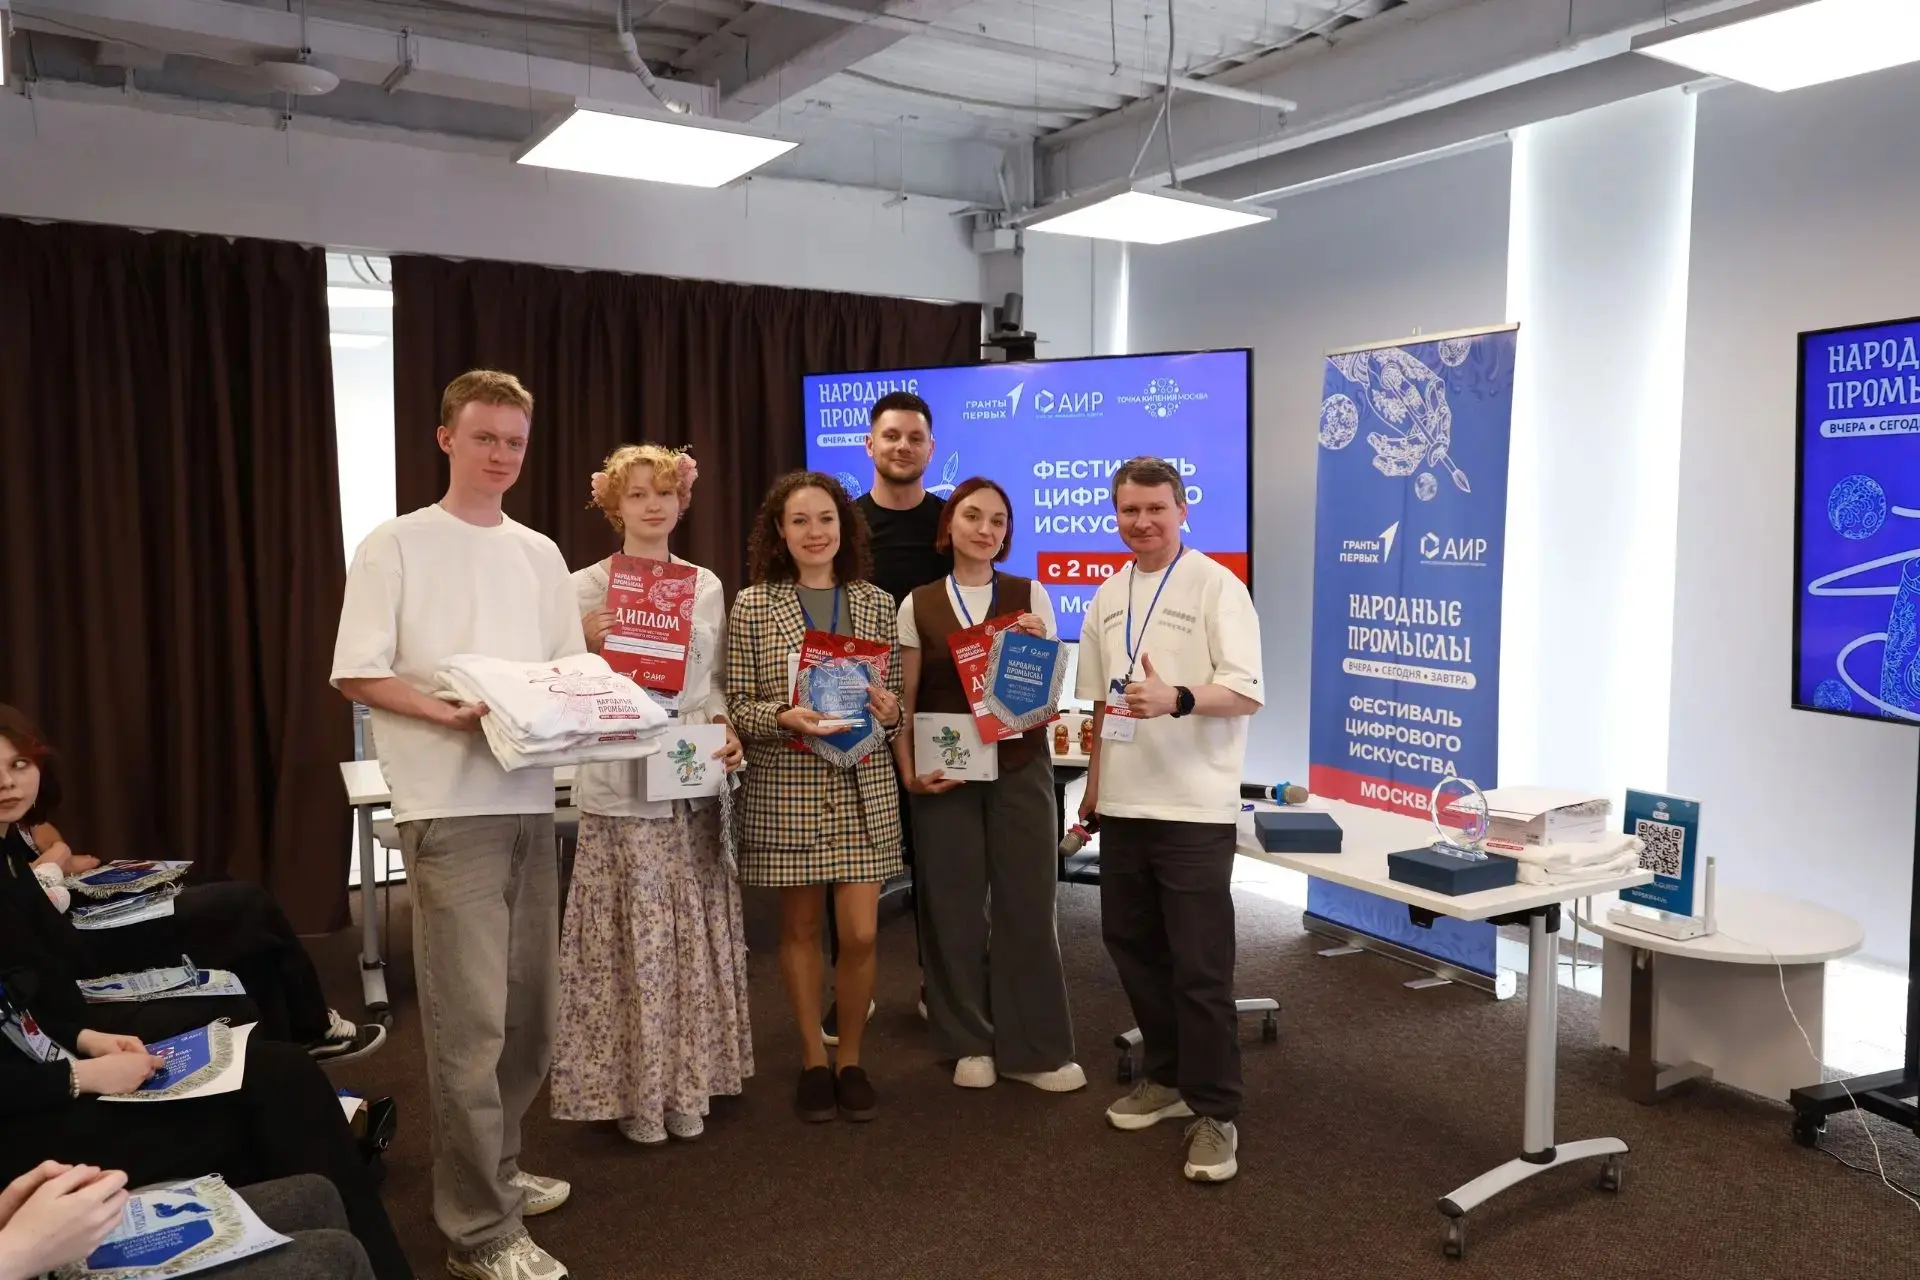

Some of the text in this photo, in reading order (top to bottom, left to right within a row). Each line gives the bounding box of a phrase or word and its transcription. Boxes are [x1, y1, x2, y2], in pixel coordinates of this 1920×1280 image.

[1828, 336, 1920, 373] НАРОД
[965, 399, 1007, 409] ГРАНТЫ
[1058, 391, 1104, 413] АИР
[1117, 392, 1208, 404] ТОЧКА КИПЕНИЯ МОСКВА
[820, 406, 871, 428] ПРОМ
[963, 410, 1006, 420] ПЕРВЫХ
[1829, 418, 1920, 434] ВЧЕРА СЕГОД
[823, 435, 846, 445] ВЧЕРА
[1034, 485, 1203, 509] ЦИФРО
[1035, 514, 1191, 534] ИСКУСА
[1343, 540, 1380, 551] ГРАНТЫ
[1442, 538, 1488, 561] АИР
[1048, 563, 1061, 577] с
[1067, 559, 1081, 577] 2
[1086, 562, 1114, 577] по
[1339, 553, 1379, 563] ПЕРВЫХ
[615, 607, 680, 631] ДИПЛОМ
[1349, 593, 1462, 627] НАРОДНЫЕ
[1348, 625, 1472, 663] ПРОМЫСЛЫ
[650, 672, 666, 681] АИР
[1006, 666, 1043, 680] ПРОМЫСЛЫ
[1348, 661, 1468, 686] ВЧЕРА СЕГОДНЯ ЗАВТРА
[1349, 695, 1463, 728] ФЕСТИВАЛЬ
[1345, 717, 1462, 753] ЦИФРОВОГО
[1349, 740, 1458, 777] ИСКУССТВА
